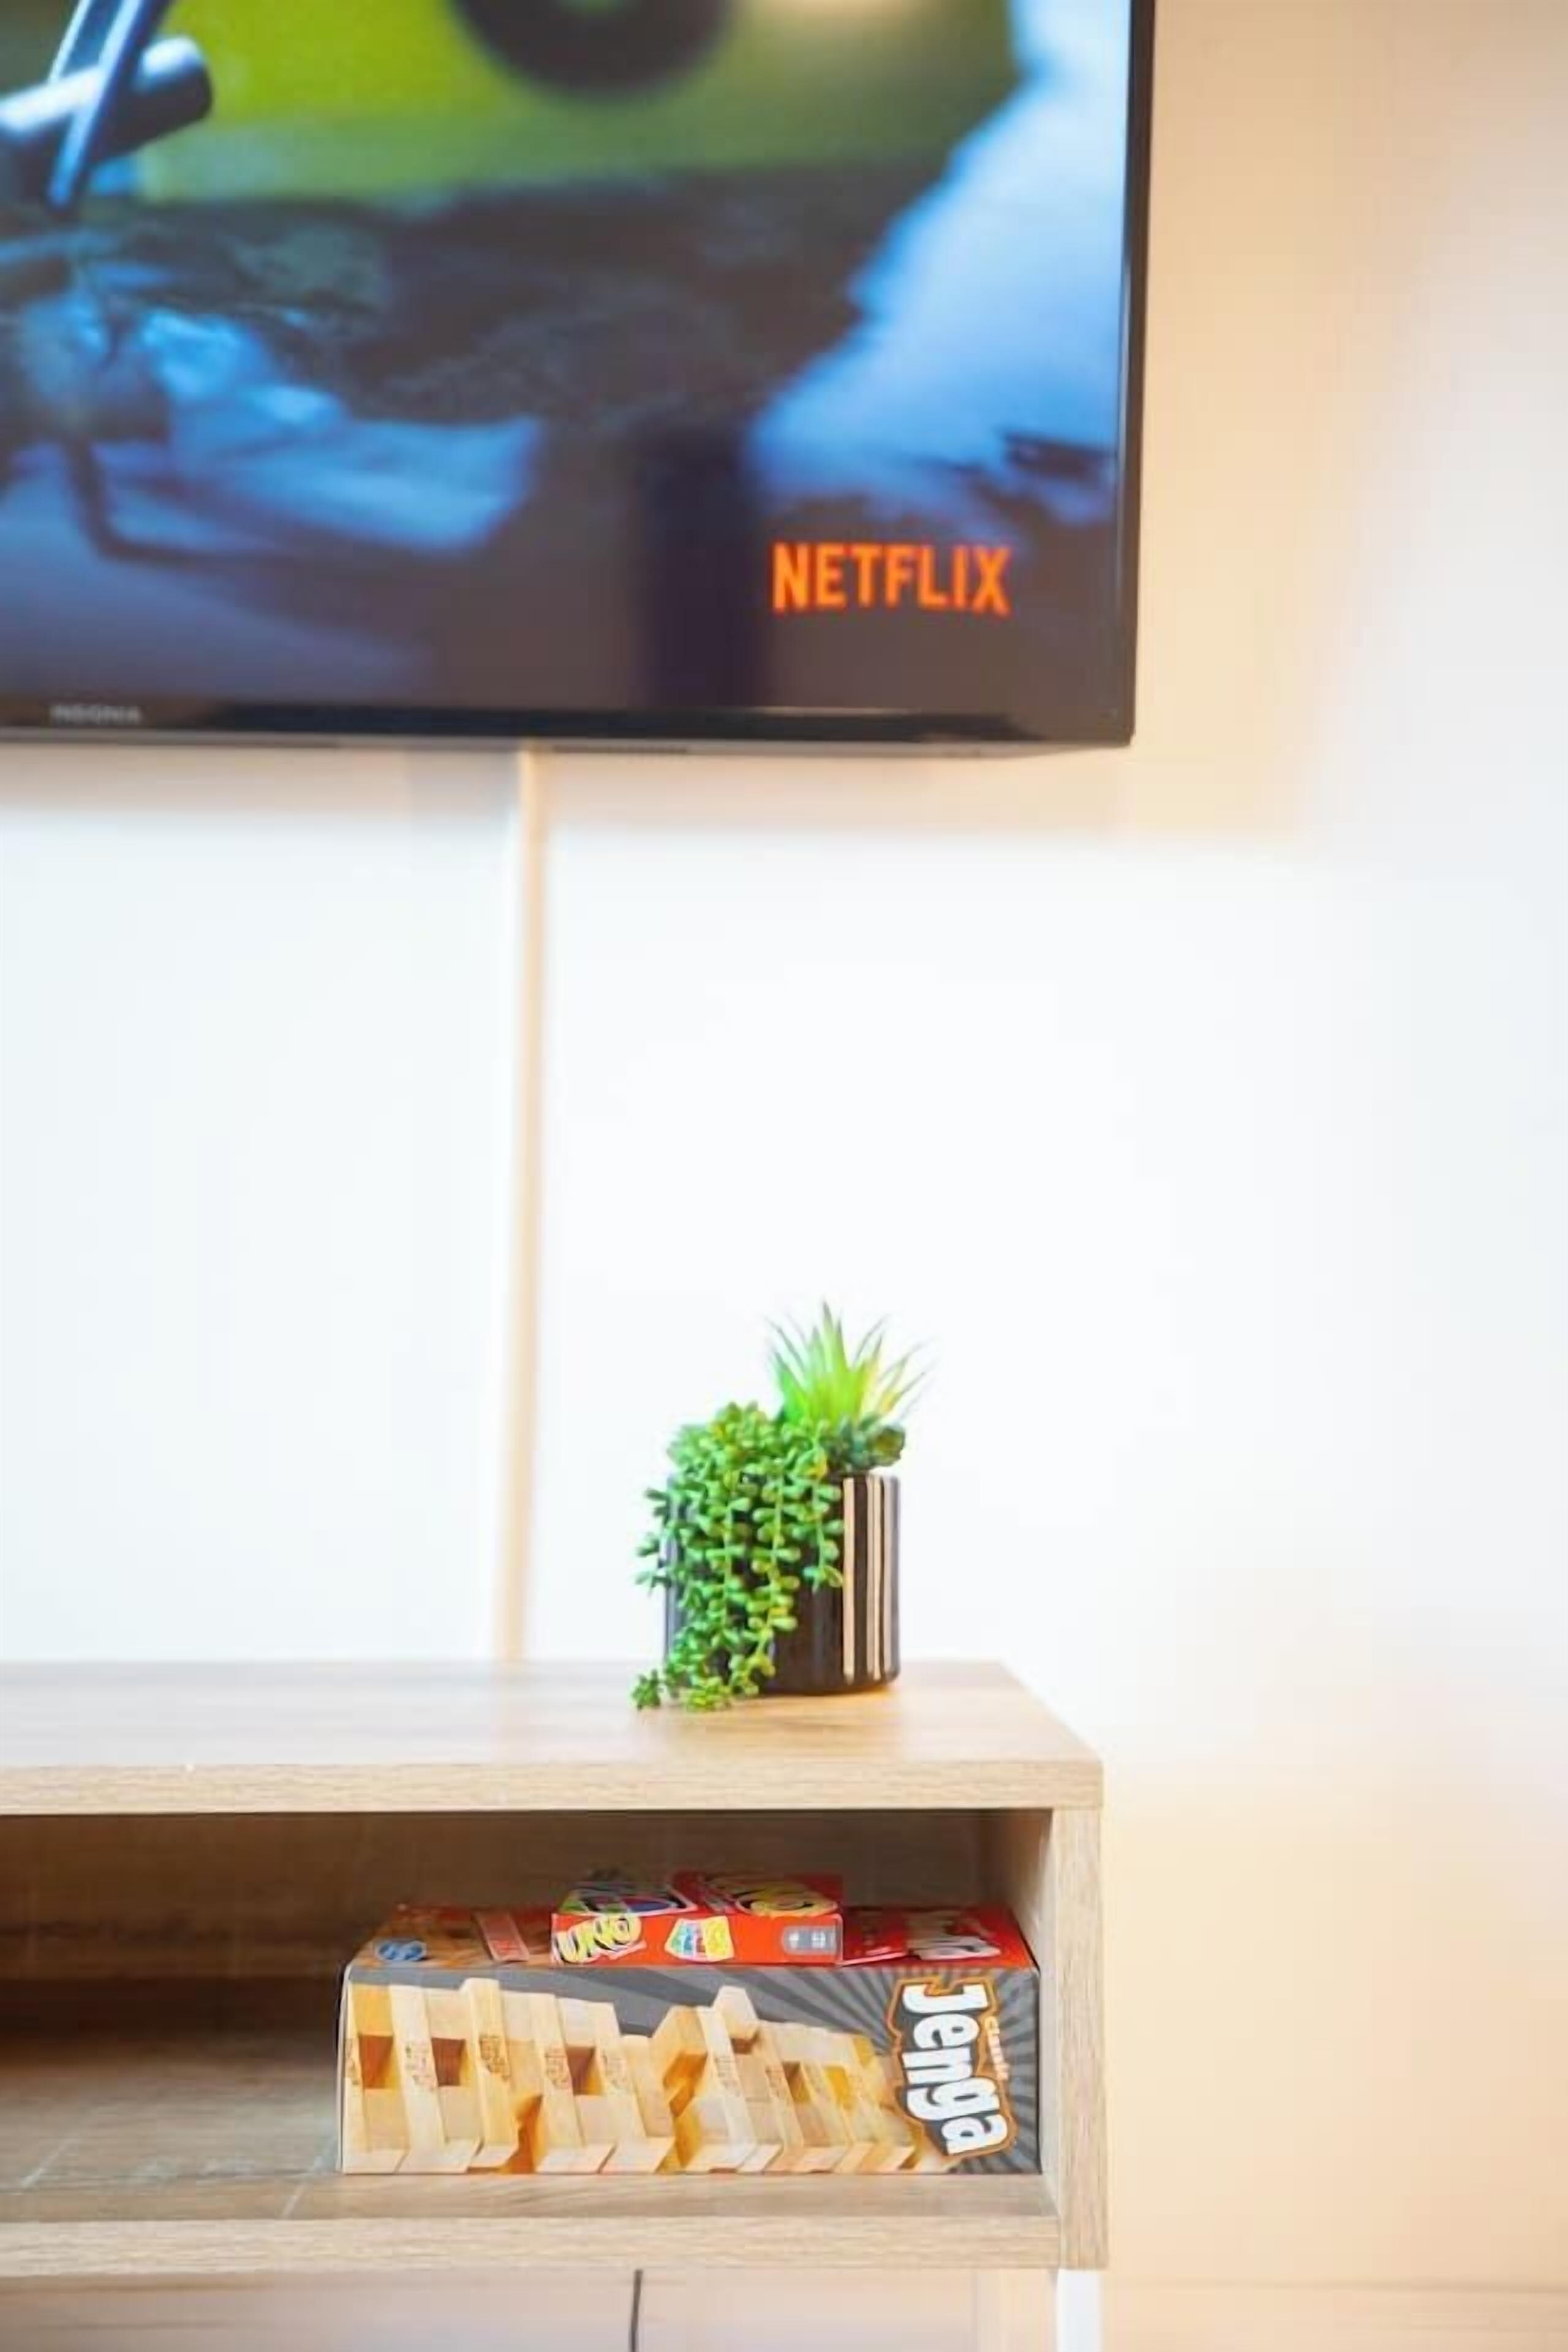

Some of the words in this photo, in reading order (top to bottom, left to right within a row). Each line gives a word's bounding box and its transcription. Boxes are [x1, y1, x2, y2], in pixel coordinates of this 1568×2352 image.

[771, 541, 1011, 616] NETFLIX
[554, 1915, 642, 1963] UNO
[902, 1983, 1008, 2155] Jenga
